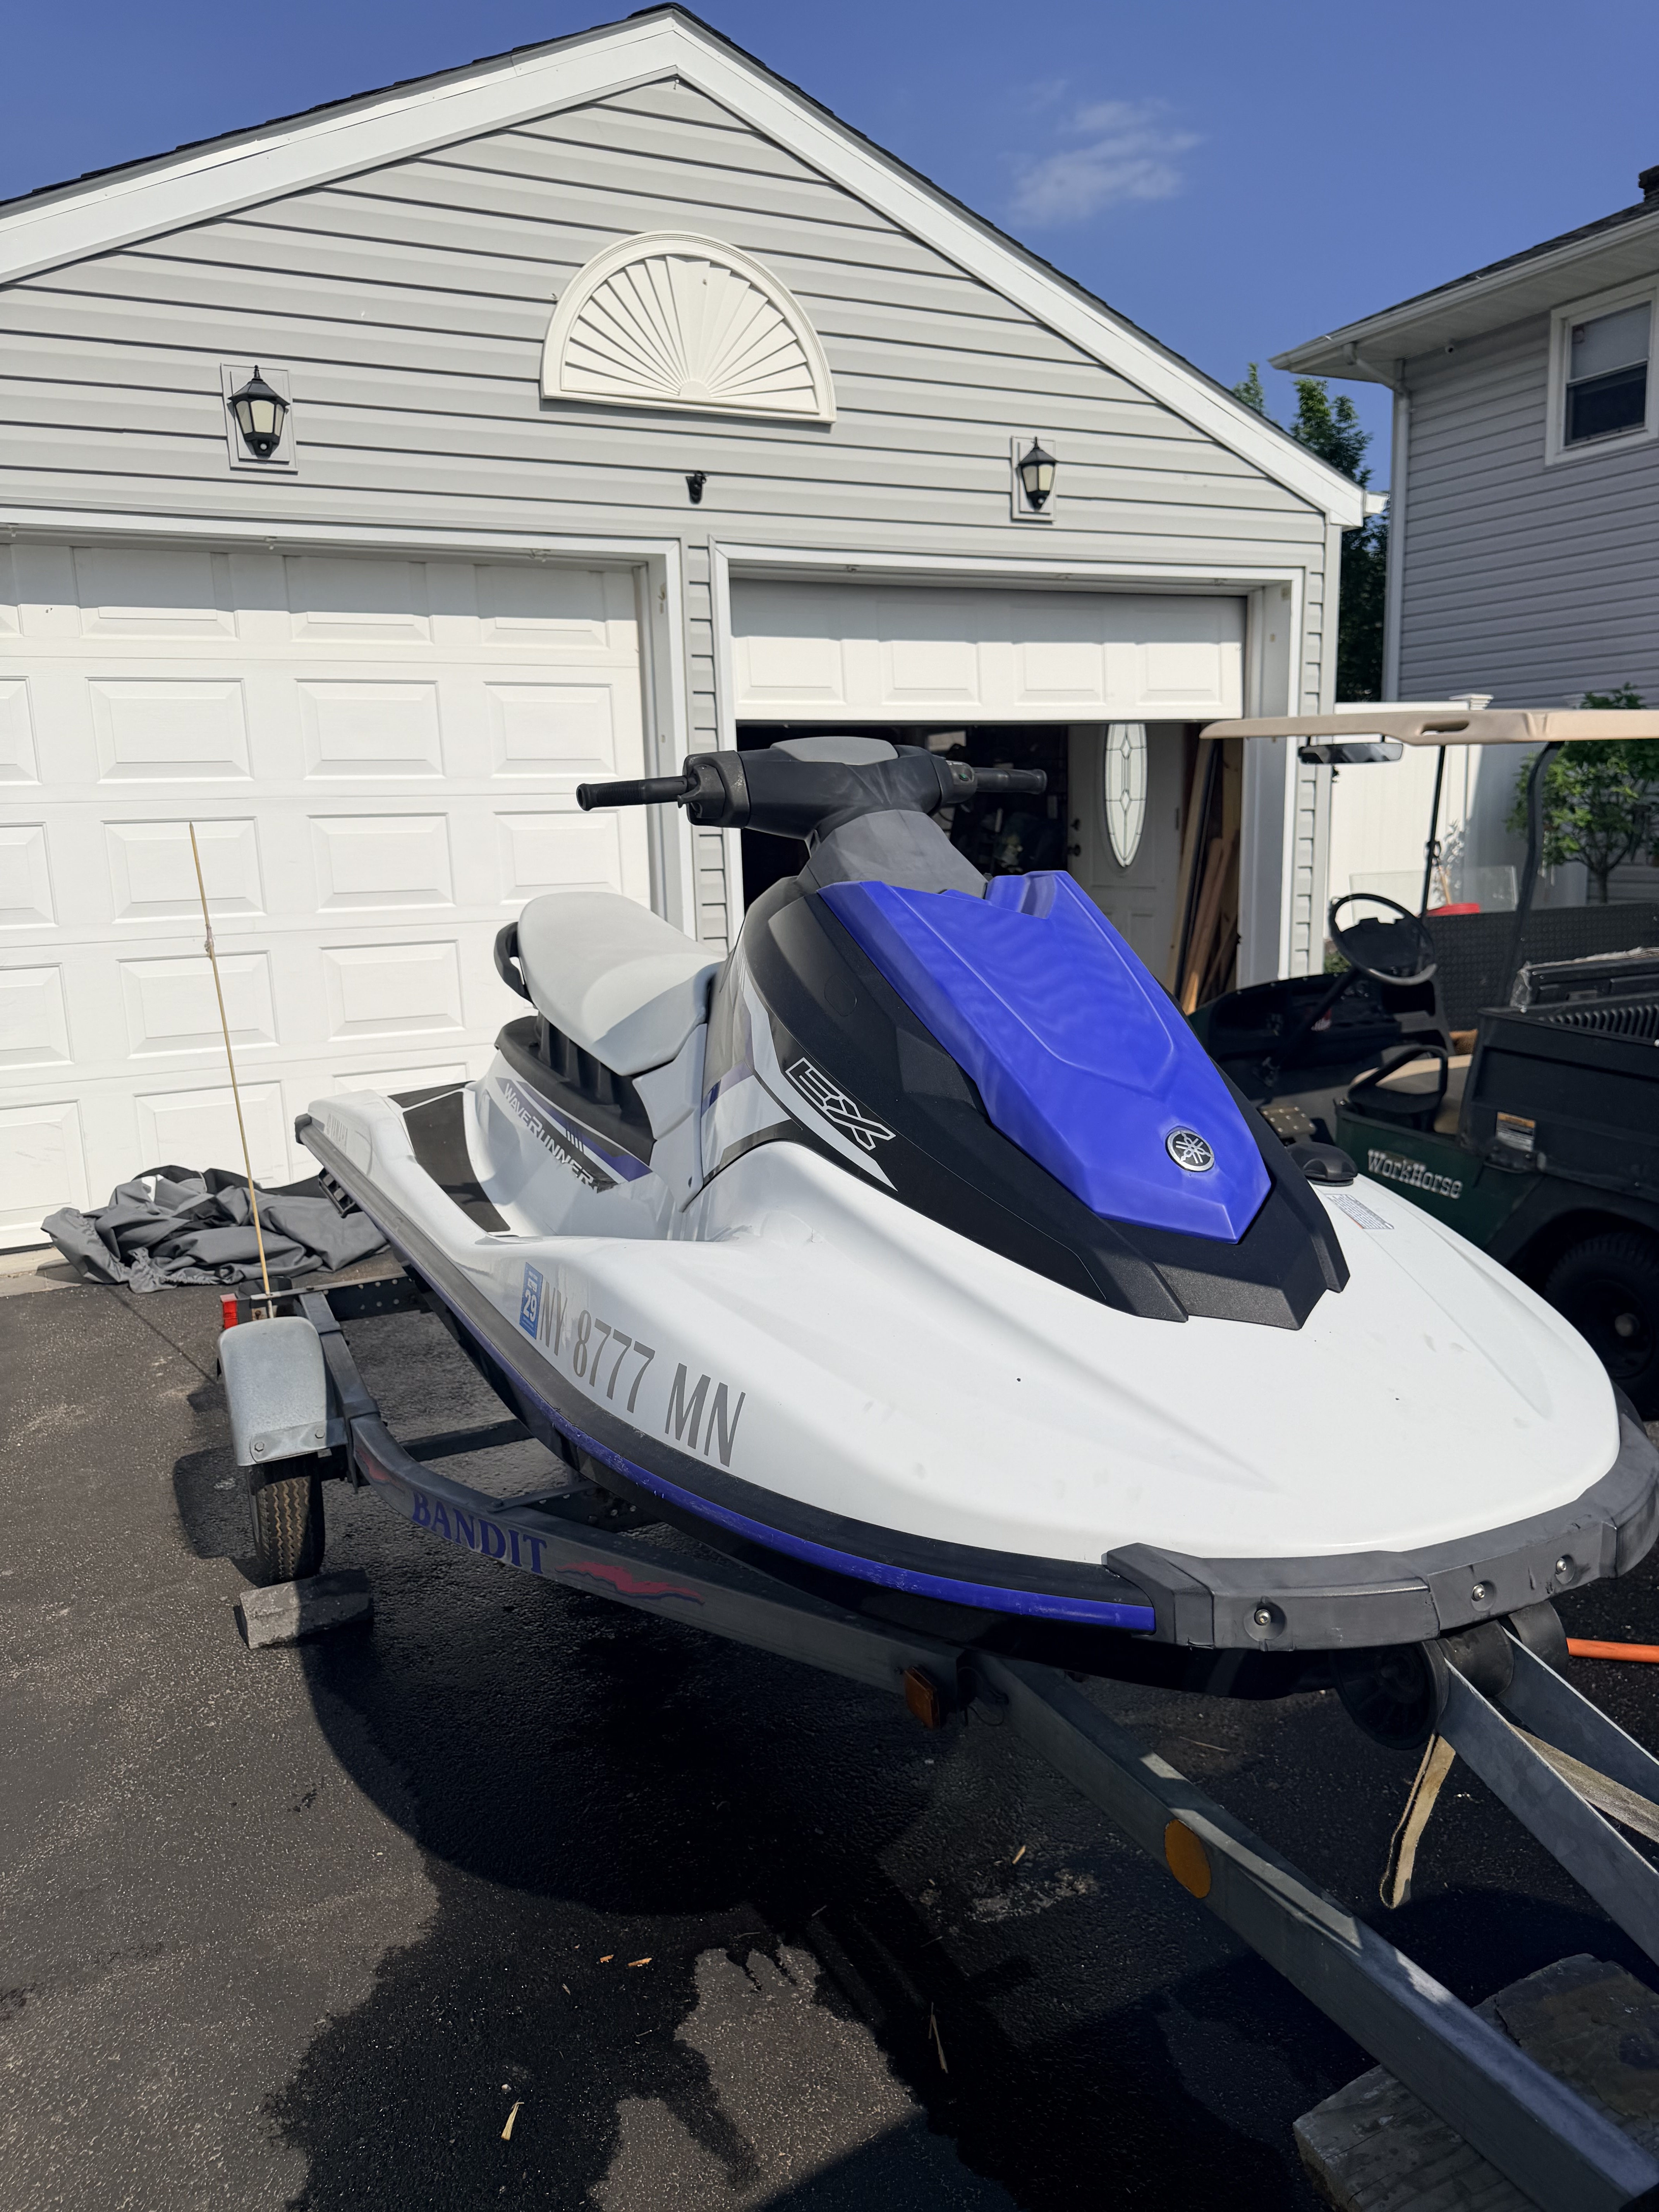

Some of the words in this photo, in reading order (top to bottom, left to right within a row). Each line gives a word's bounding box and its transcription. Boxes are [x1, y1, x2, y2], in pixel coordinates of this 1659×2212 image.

[785, 1057, 896, 1151] EX
[1367, 1149, 1463, 1199] WorkHorse
[523, 1289, 537, 1322] 29
[540, 1281, 568, 1356] NY
[573, 1309, 656, 1414] 8777
[665, 1362, 746, 1467] MN
[412, 1491, 548, 1574] BANDIT
